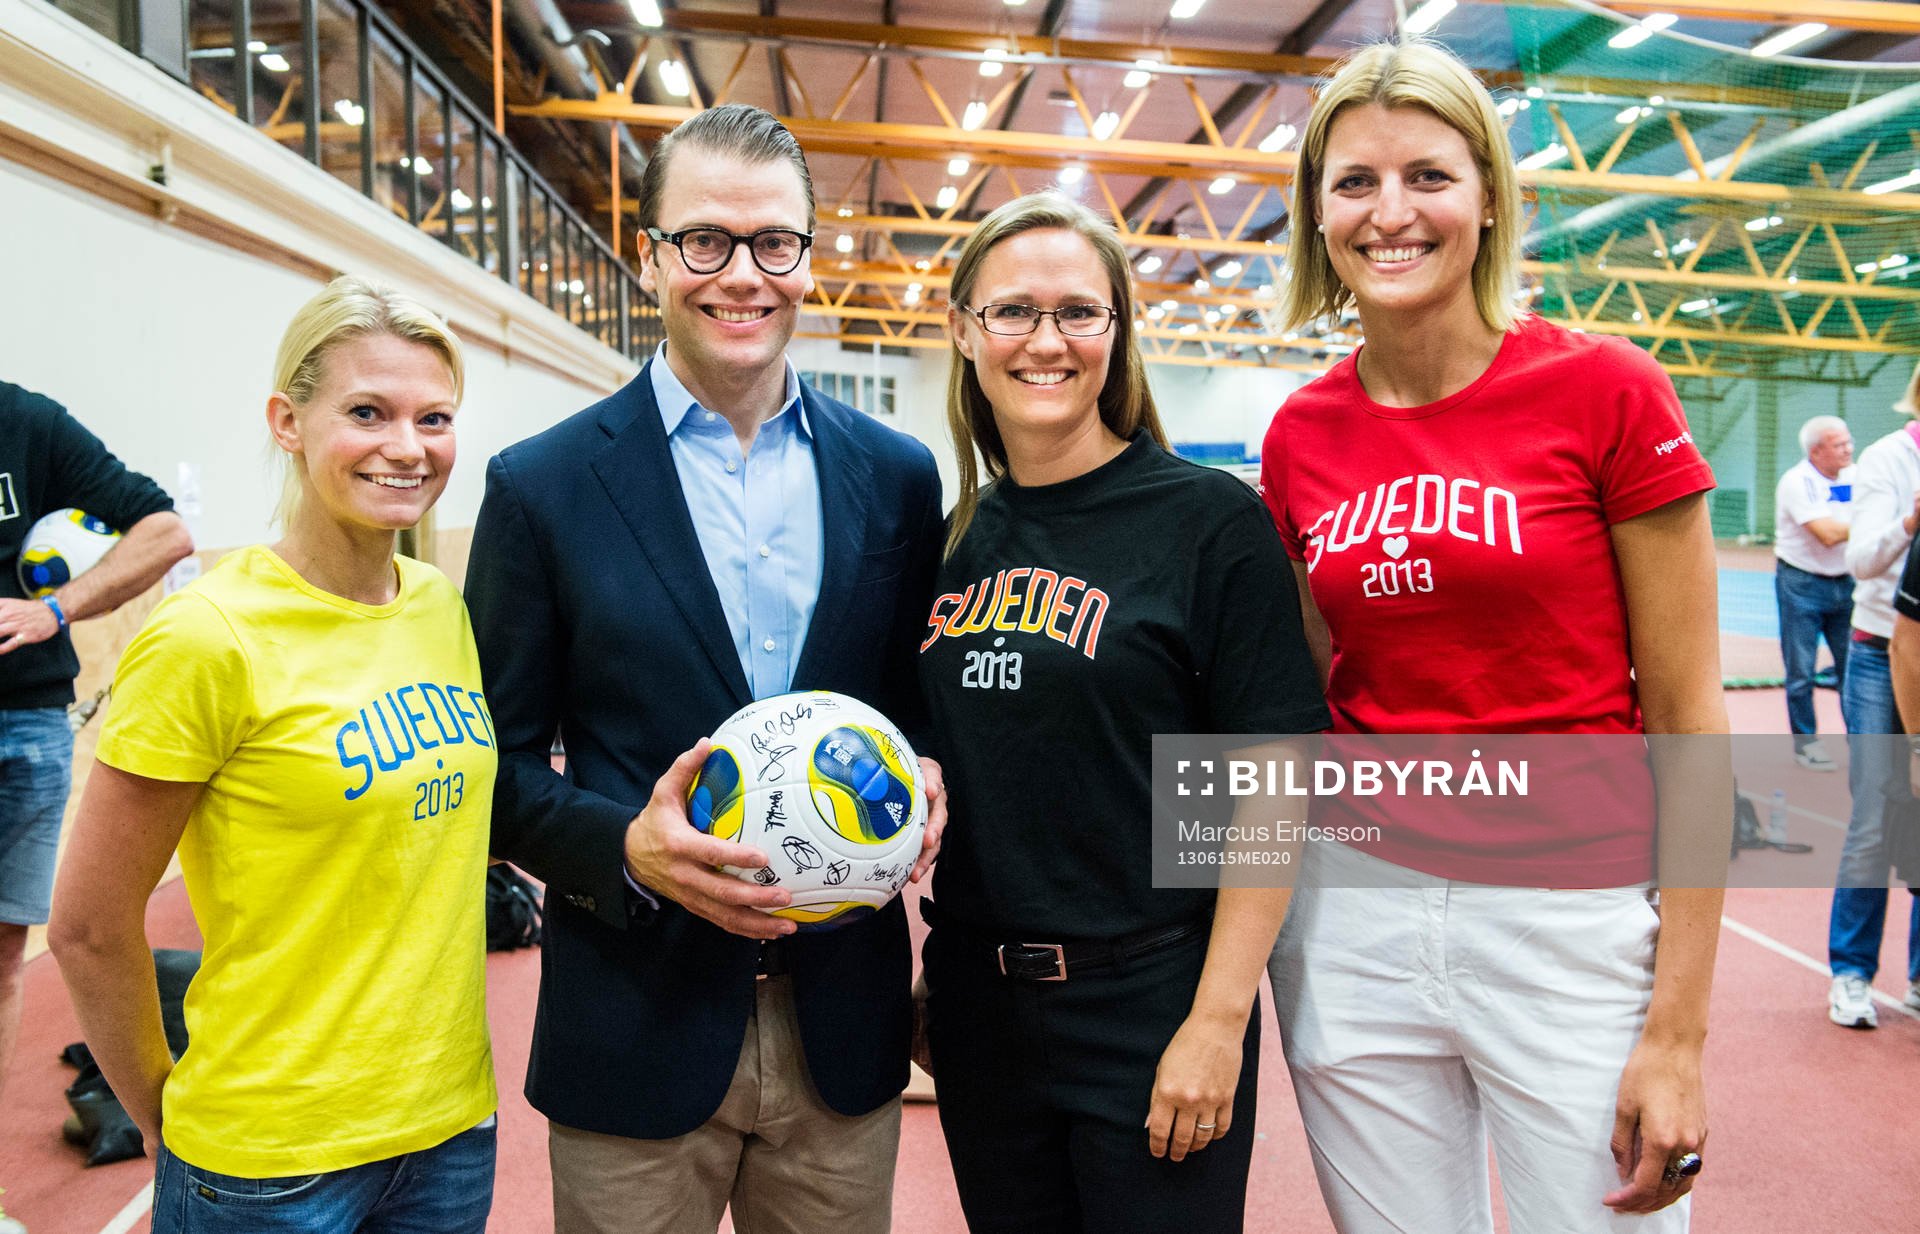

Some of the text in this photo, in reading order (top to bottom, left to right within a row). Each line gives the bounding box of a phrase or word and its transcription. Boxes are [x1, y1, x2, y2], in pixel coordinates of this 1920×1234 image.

[1308, 474, 1523, 574] SWEDEN
[1360, 558, 1434, 598] 2013
[919, 567, 1110, 660] SWEDEN
[962, 650, 1023, 690] 2013
[414, 772, 464, 821] 2013
